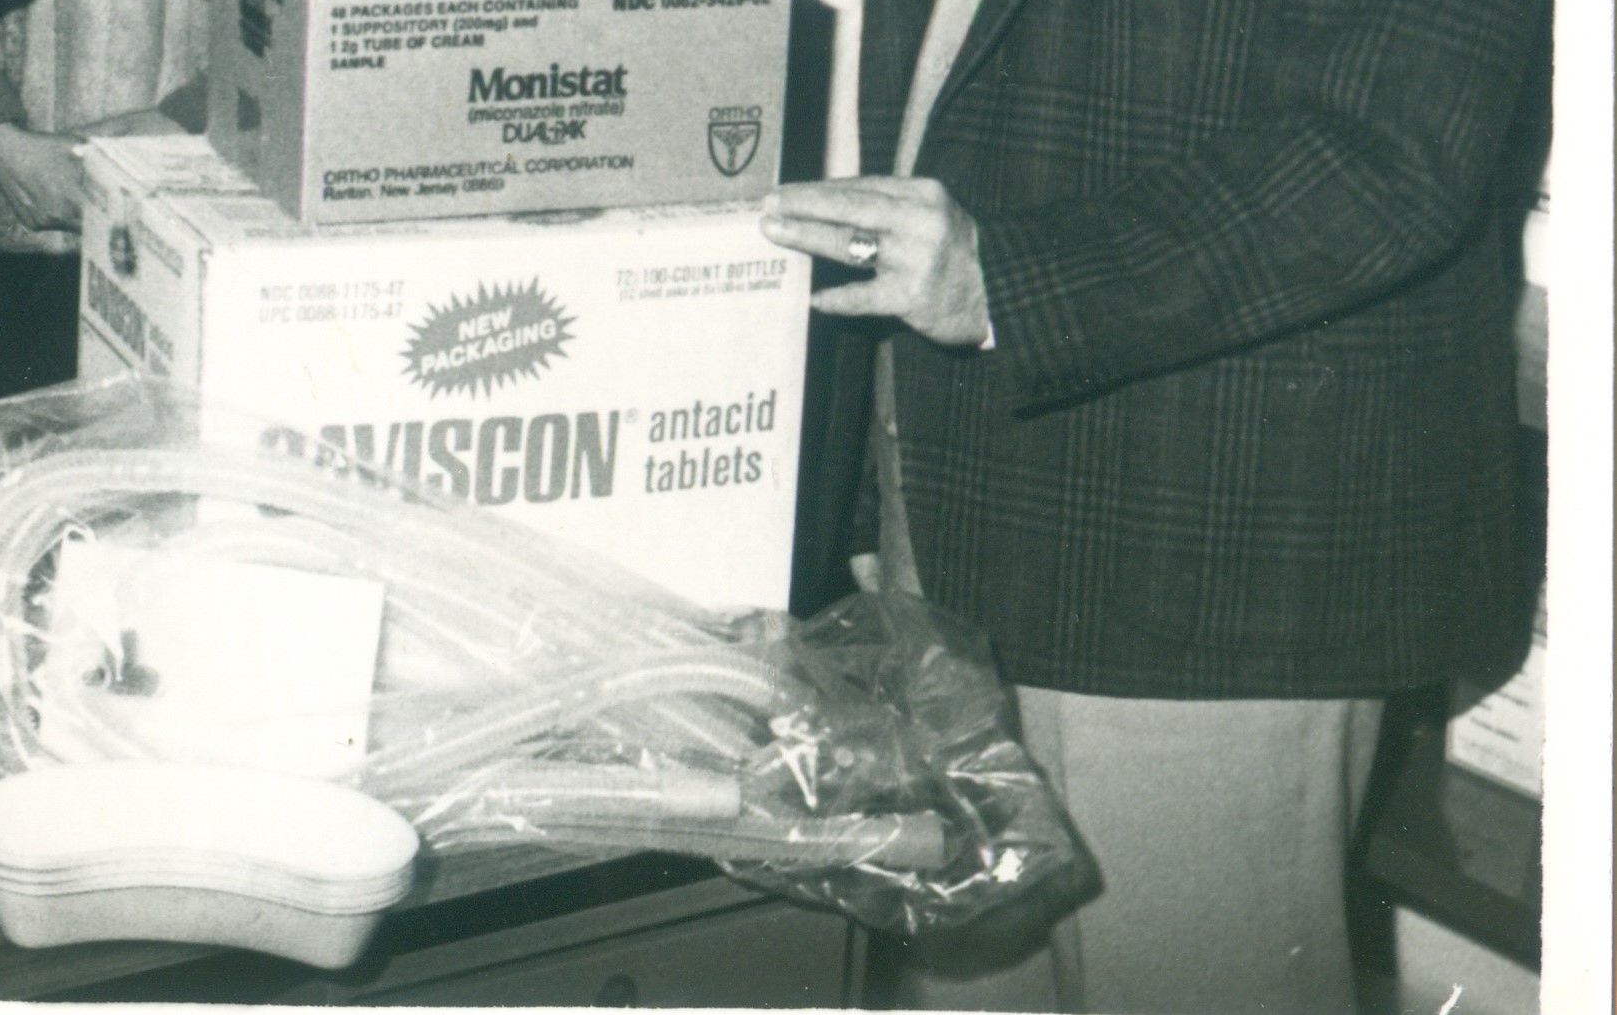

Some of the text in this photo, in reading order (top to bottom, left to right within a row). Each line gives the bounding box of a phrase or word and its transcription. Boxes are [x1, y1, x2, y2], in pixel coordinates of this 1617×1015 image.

[351, 0, 432, 18] PACKAGES
[437, 0, 478, 13] EACH
[342, 19, 448, 36] SUPPOSITORY
[453, 17, 508, 32] (200mg)
[512, 16, 538, 28] and
[363, 37, 402, 51] TUBE
[406, 37, 427, 49] OF
[431, 33, 485, 49] CREAM
[330, 56, 386, 70] SAMPLE
[467, 62, 629, 103] Monistat
[468, 99, 625, 124] (miconazole nitrate)
[708, 105, 762, 122] ORTHO
[323, 155, 634, 185] ORTHO PHARMACEUTICAL CORPORATION
[380, 185, 411, 197] New
[415, 182, 459, 197] Jersey
[726, 258, 787, 279] BOTTLES
[260, 284, 294, 301] NDC
[259, 305, 292, 324] UPC
[458, 306, 513, 342] NEW
[420, 318, 557, 376] PACKAGING
[647, 389, 777, 443] antacid
[643, 445, 763, 494] tablets
